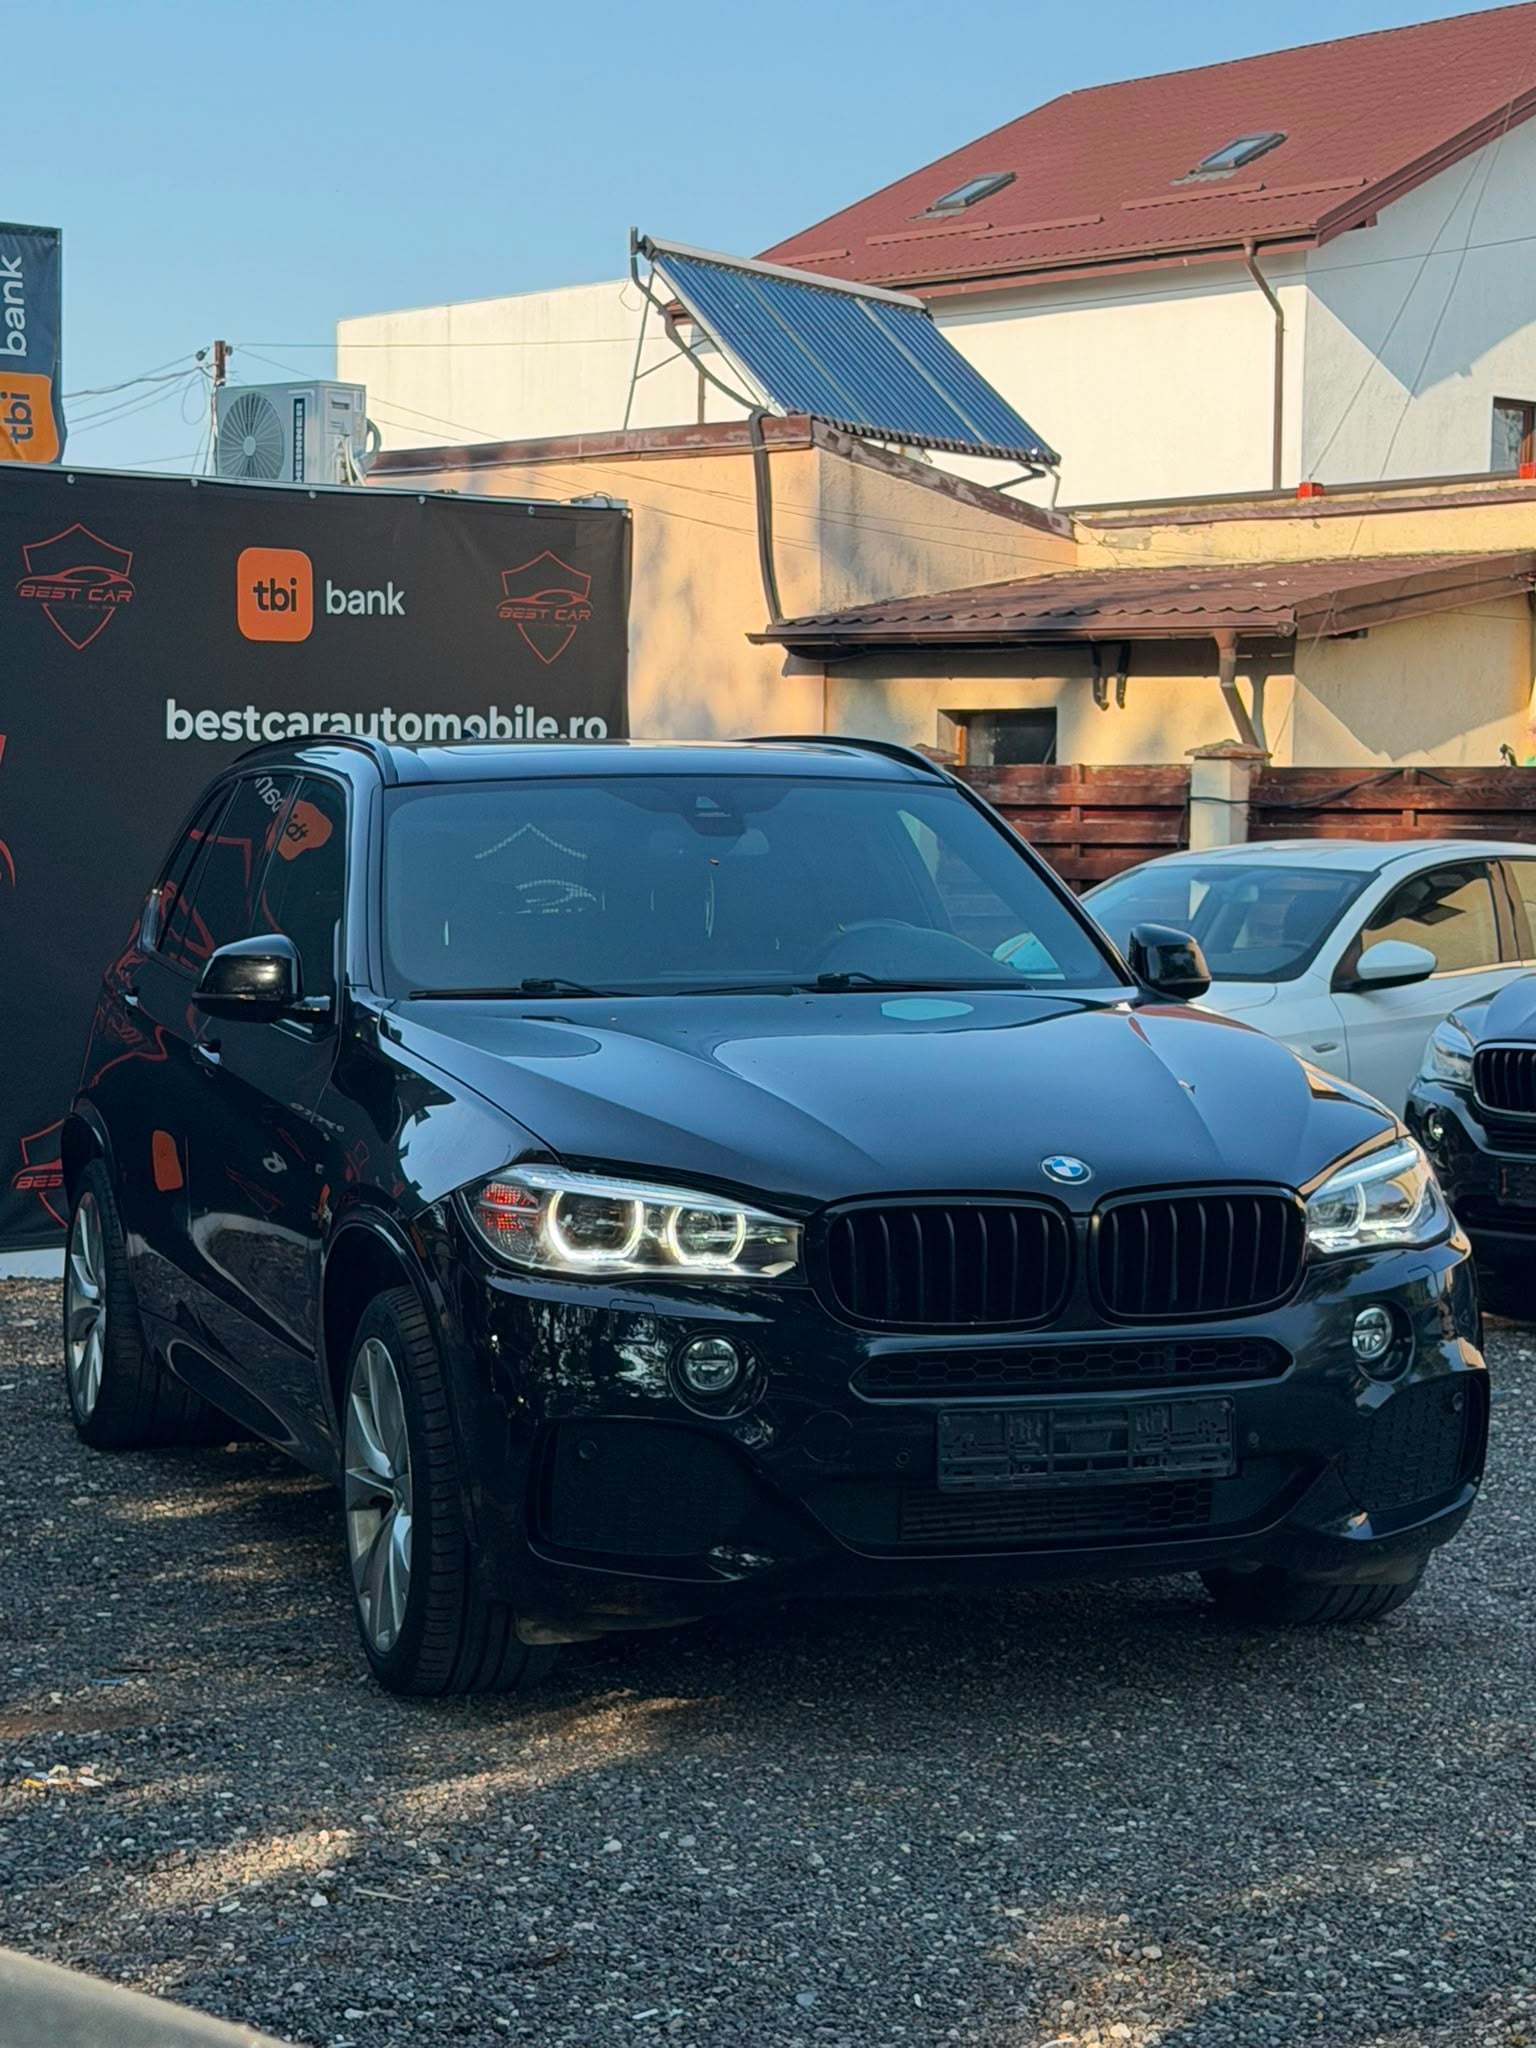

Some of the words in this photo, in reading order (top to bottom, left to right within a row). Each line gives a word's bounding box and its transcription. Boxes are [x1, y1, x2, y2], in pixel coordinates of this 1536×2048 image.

[0, 256, 27, 357] bank
[0, 392, 33, 444] tbi
[20, 585, 81, 600] BEST
[87, 588, 132, 603] CAR
[253, 578, 297, 612] tbi
[326, 580, 406, 615] bank
[499, 607, 550, 620] BEST
[554, 609, 591, 621] CAR
[166, 698, 608, 742] bestcarautomobile.ro
[16, 1174, 64, 1189] BES
